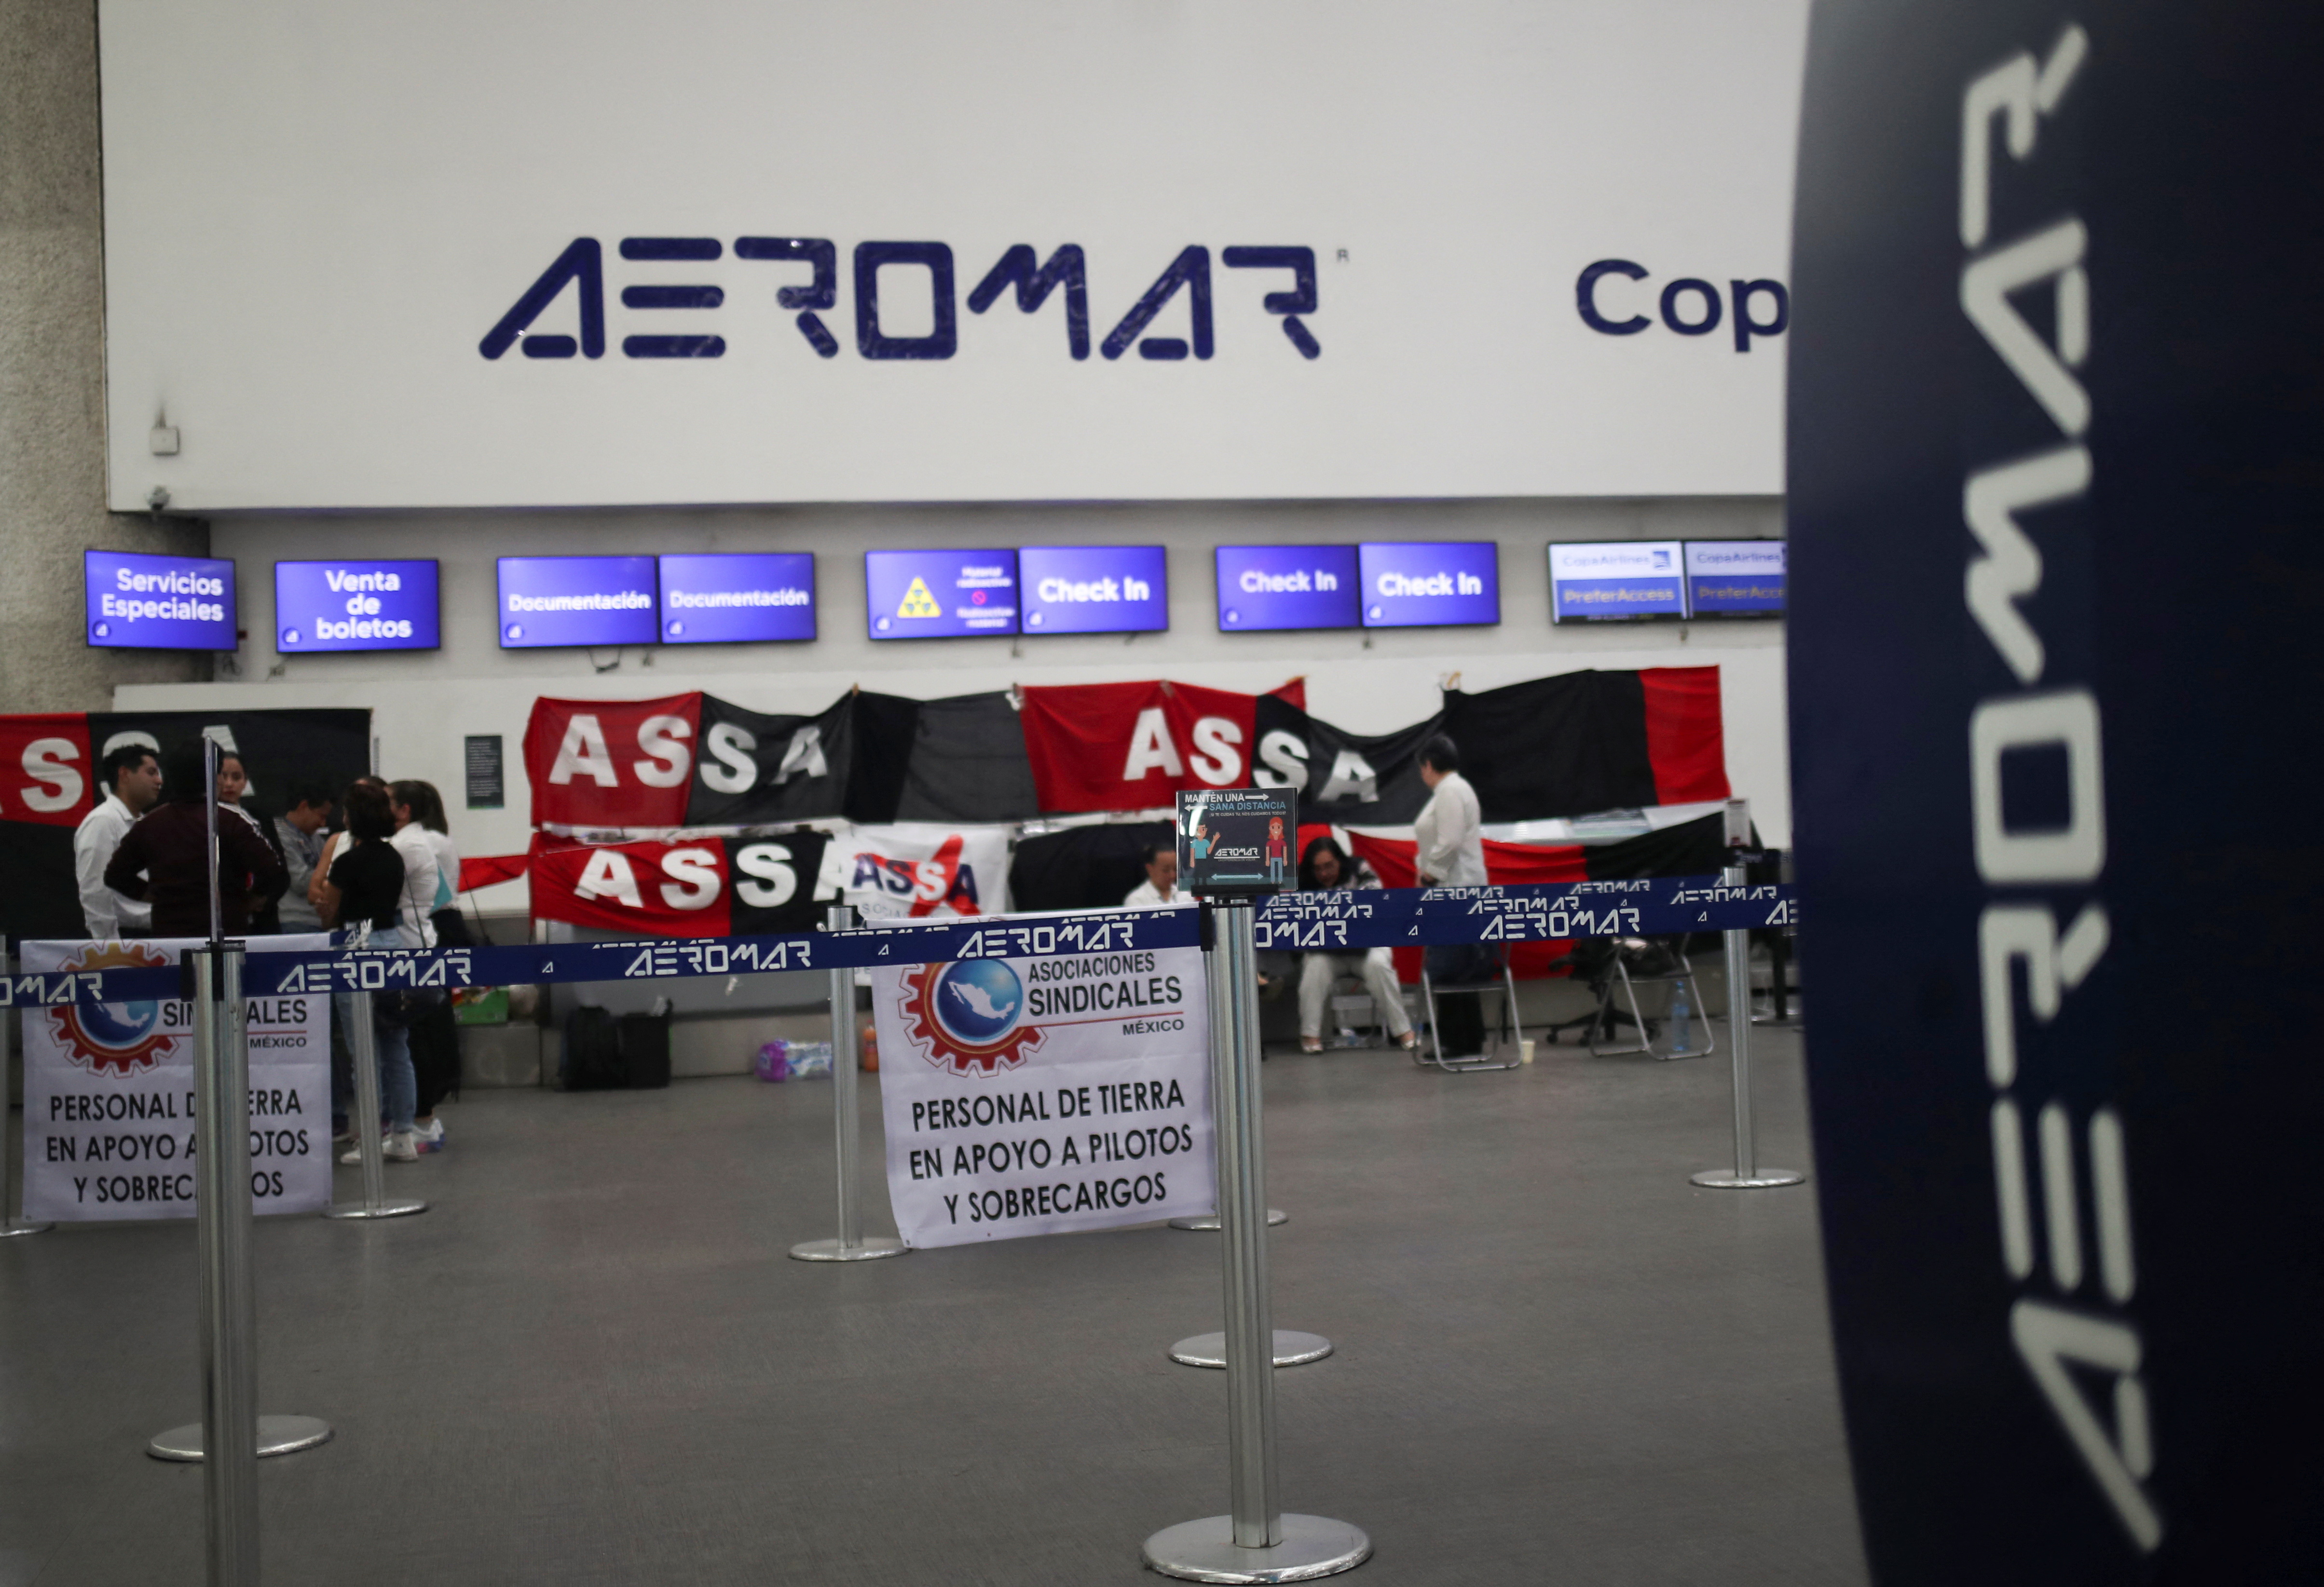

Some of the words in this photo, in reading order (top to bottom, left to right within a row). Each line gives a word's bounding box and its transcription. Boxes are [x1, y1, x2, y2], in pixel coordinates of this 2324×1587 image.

[478, 236, 1321, 361] AEROMAR
[117, 568, 224, 597] Servicios
[326, 570, 401, 593] Venta
[1038, 577, 1120, 603] Check
[1124, 576, 1149, 601] In
[1240, 570, 1312, 593] Check
[1315, 570, 1338, 591] In
[1377, 572, 1454, 597] Check
[1458, 571, 1482, 596] In
[102, 594, 224, 623] Especiales
[346, 594, 381, 616] de
[508, 591, 651, 612] Documentación
[670, 588, 809, 609] Documentación
[316, 617, 413, 640] boletos
[548, 714, 827, 792] ASSA
[1123, 706, 1380, 802] ASSA
[1185, 792, 1223, 803] MANTÉN
[1226, 793, 1245, 802] UNA
[1960, 23, 2162, 1552] AEROMAR
[1209, 802, 1234, 811] SANA
[1237, 801, 1286, 811] DISTANCIA
[1215, 847, 1258, 856] AEROMAR
[851, 854, 979, 902] ASSA
[1569, 880, 1650, 895] AEROMAR
[1265, 892, 1353, 907] AEROMAR
[1420, 886, 1504, 901] AEROMAR
[1479, 908, 1640, 940] AEROMAR
[956, 922, 1134, 958] AEROMAR
[624, 940, 811, 977] AEROMAR
[1028, 952, 1155, 983] ASOCIACIONES
[276, 957, 471, 993] AEROMAR
[1028, 976, 1183, 1017] SINDICALES
[163, 999, 307, 1027] SIALES
[1122, 1019, 1185, 1036] MÉXICO
[249, 1035, 307, 1049] MÉXICO
[51, 1093, 177, 1122] PERSONAL
[912, 1091, 1050, 1132] PERSONAL
[1058, 1087, 1091, 1119] DE
[1097, 1079, 1186, 1115] TIERRA
[47, 1136, 76, 1162] EN
[85, 1132, 176, 1162] APOYO
[909, 1148, 943, 1180] EN
[953, 1138, 1051, 1176] APOYO
[1061, 1136, 1081, 1166] A
[1089, 1124, 1193, 1164] PILOTOS
[73, 1177, 88, 1203] Y
[97, 1170, 284, 1203] SOBRECOS
[943, 1194, 958, 1225] Y
[968, 1172, 1167, 1223] SOBRECARGOS
